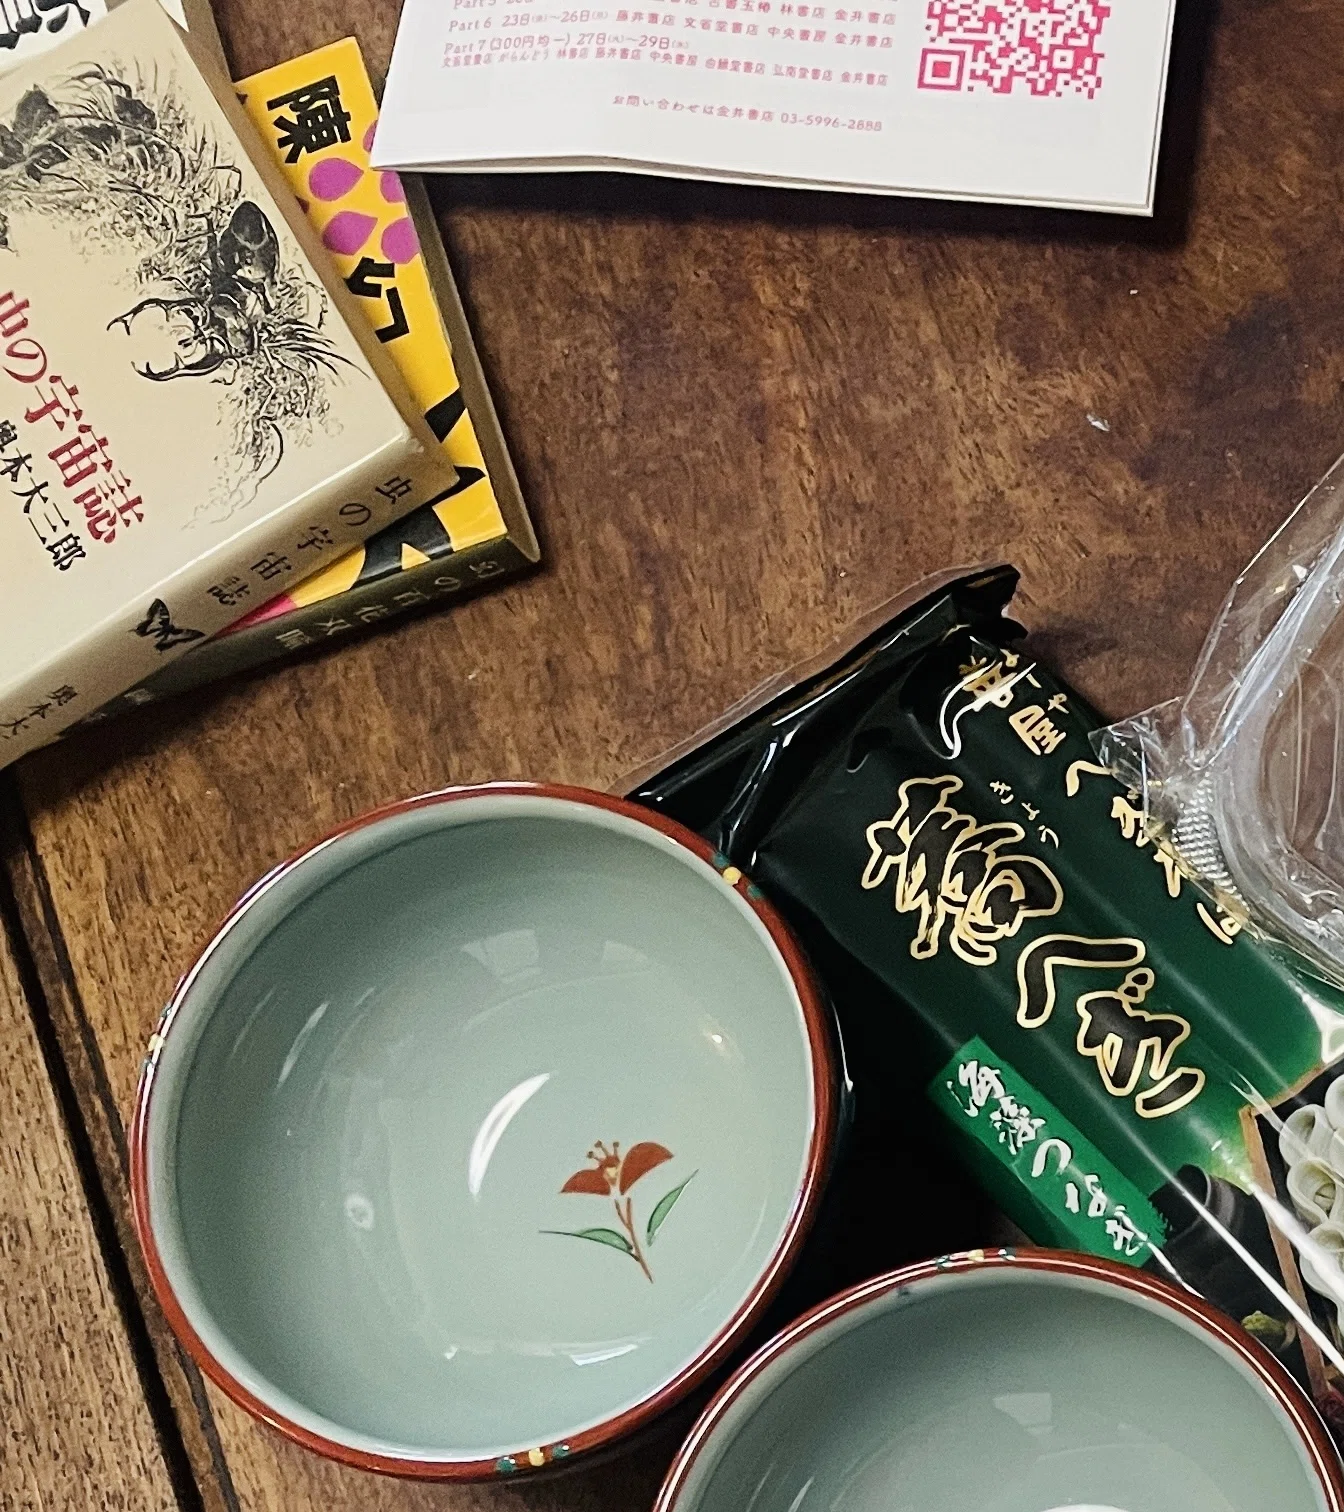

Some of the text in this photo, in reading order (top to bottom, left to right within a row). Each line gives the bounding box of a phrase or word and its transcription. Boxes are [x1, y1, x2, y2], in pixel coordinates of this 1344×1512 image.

[444, 42, 474, 55] Part
[478, 40, 487, 51] 7
[449, 20, 480, 32] Part
[483, 17, 492, 29] 6
[266, 74, 354, 164] 陳
[207, 475, 413, 606] 虫の宇宙誌
[0, 684, 78, 740] 奥本大
[990, 780, 1060, 850] きょう
